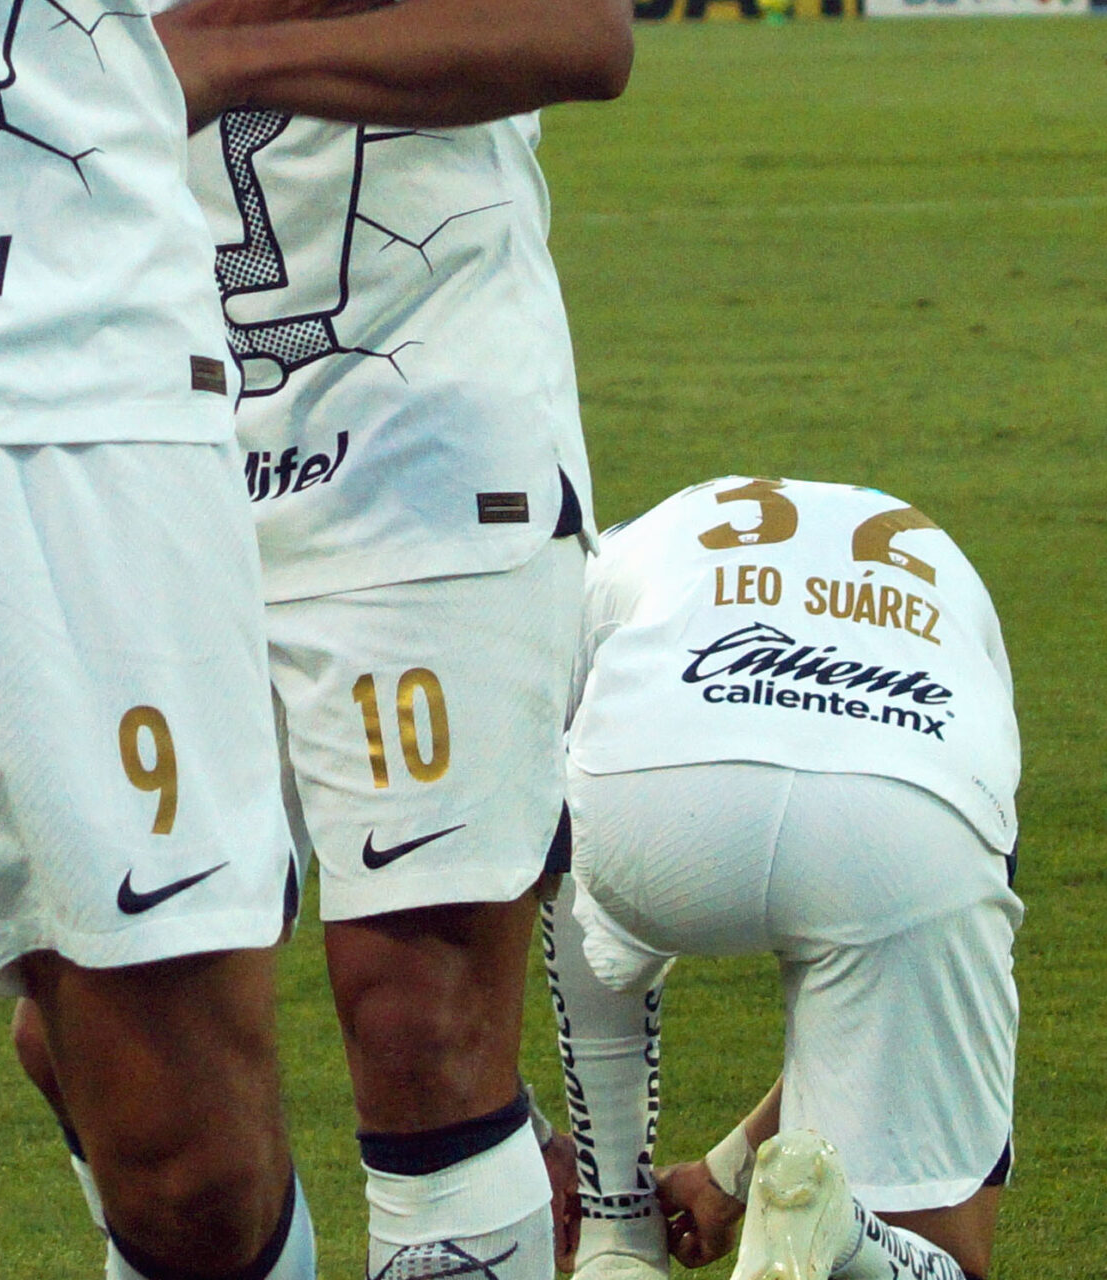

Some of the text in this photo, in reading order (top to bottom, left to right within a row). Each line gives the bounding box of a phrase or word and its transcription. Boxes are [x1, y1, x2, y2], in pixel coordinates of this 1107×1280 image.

[714, 565, 942, 646] LEO SUÁREZ
[682, 622, 954, 706] Caliente
[352, 667, 450, 789] 10
[702, 679, 946, 741] caliente.mx
[118, 705, 178, 835] 9
